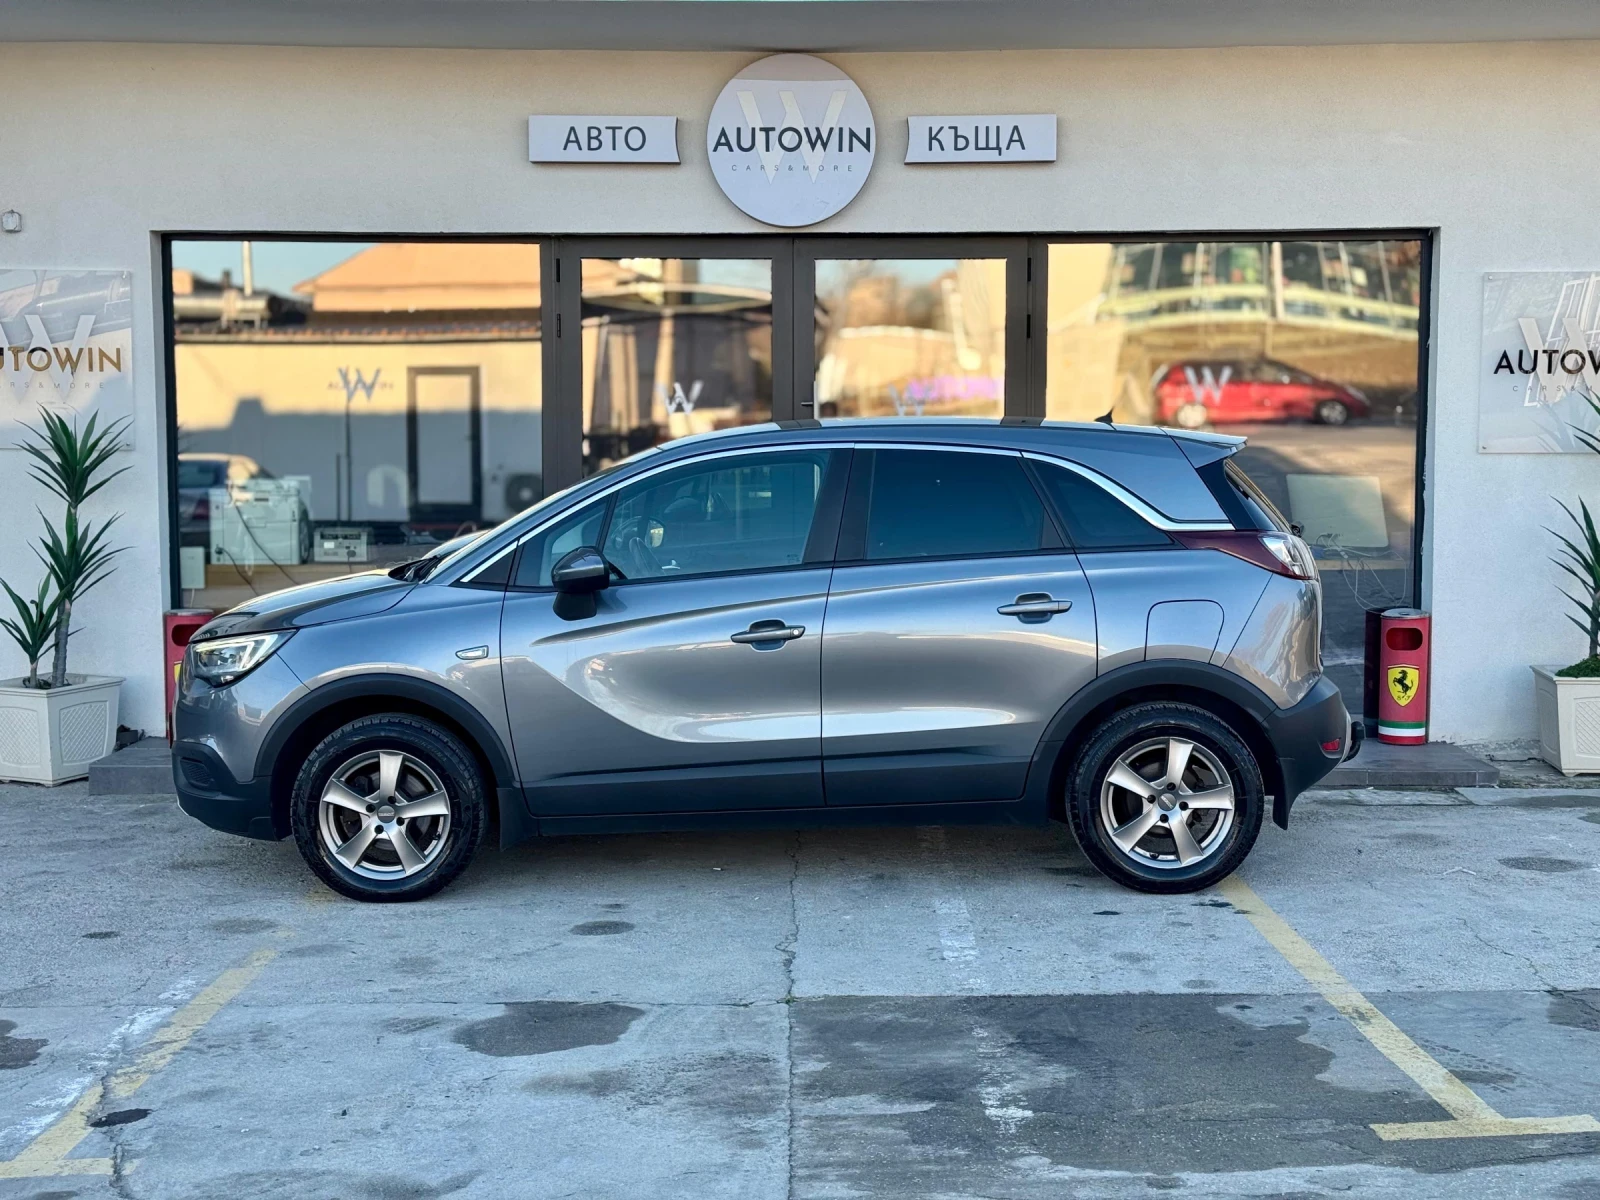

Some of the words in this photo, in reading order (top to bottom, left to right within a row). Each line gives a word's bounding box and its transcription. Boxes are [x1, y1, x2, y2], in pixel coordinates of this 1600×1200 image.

[563, 126, 647, 152] АВТО
[712, 126, 871, 153] AUTOWIN
[928, 125, 1026, 156] КЪЩА
[0, 346, 122, 373] TOWIN
